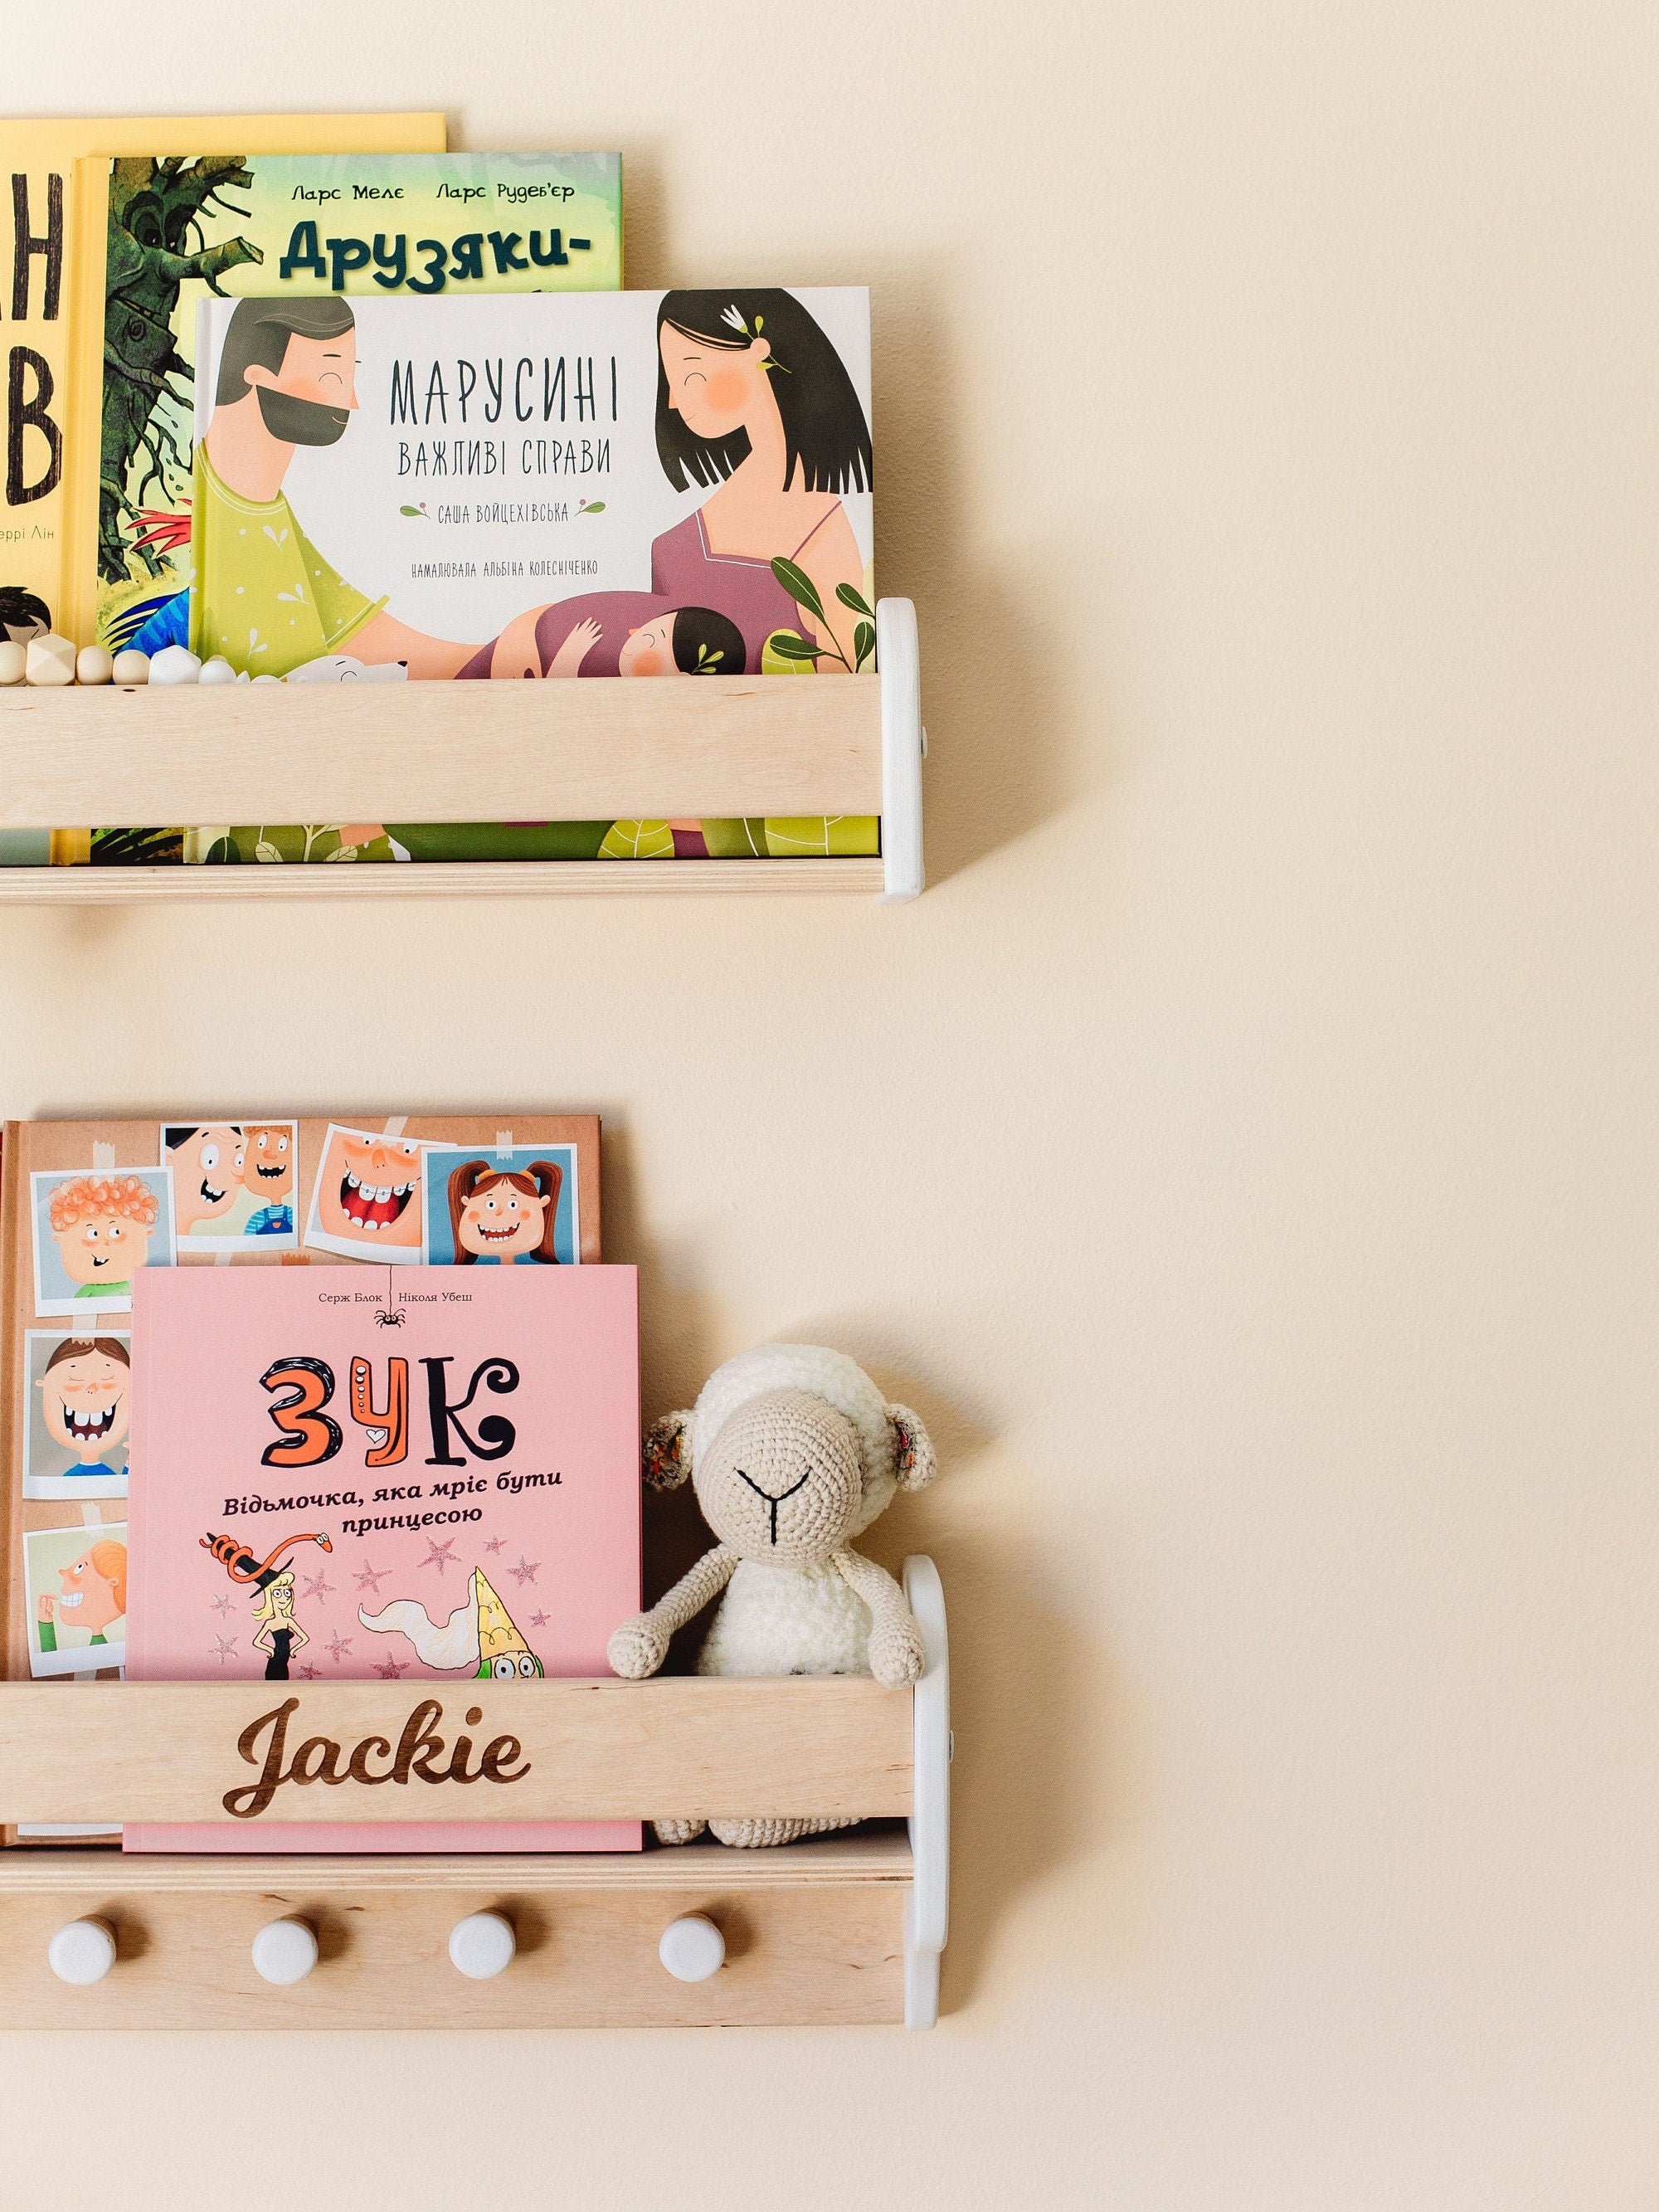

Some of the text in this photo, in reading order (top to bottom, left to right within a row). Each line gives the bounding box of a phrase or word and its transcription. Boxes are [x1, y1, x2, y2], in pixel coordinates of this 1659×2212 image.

[291, 184, 405, 206] Ларс Мелє
[435, 183, 487, 204] Ларс
[280, 220, 591, 294] Друзяки-
[390, 355, 617, 426] МАРУСИНІ
[397, 438, 611, 477] ВАЖЛИВІ СПРАВИ
[438, 502, 569, 525] САША ВОЙЦЕХІВСЬКА
[31, 524, 54, 539] Лін
[411, 559, 598, 578] НАМАЛЮВАЛА АЛЬБІНА КОЛЕСНІЧЕНКО
[319, 1293, 383, 1305] Серж Блок
[398, 1292, 473, 1303] Ніколя Убеш
[259, 1355, 520, 1469] ЗУК
[222, 1470, 563, 1516] Відьмочка, яка мріє бути
[342, 1508, 484, 1537] принцесою
[221, 1697, 532, 1819] Jackie
